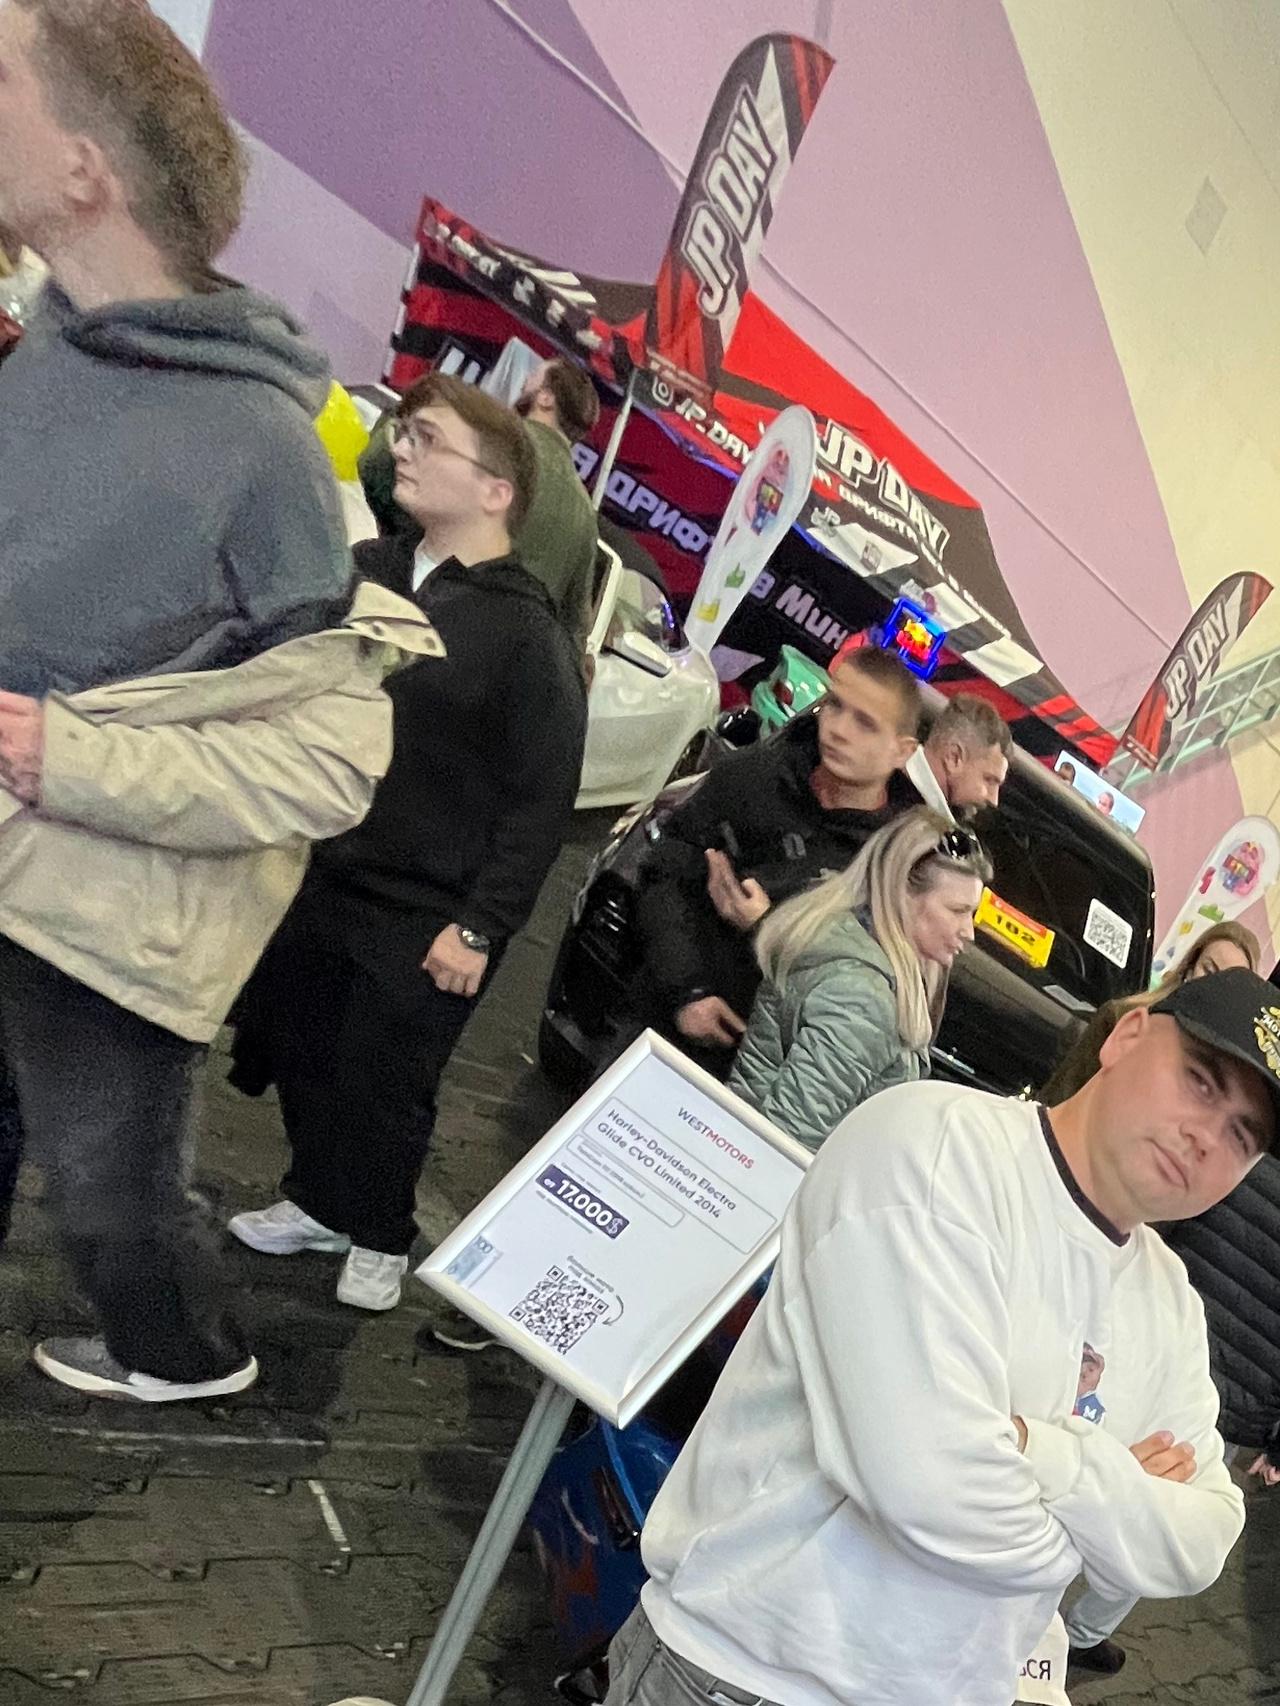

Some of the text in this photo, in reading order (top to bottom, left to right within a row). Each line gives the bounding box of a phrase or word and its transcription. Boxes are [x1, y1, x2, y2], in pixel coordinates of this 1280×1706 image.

[682, 88, 777, 317] JP DAY
[814, 422, 877, 487] JP
[880, 460, 948, 561] DAY
[1163, 597, 1229, 718] JP DAY
[597, 1121, 627, 1149] Glide
[628, 1145, 655, 1168] CVO
[653, 1164, 696, 1199] Limited
[693, 1194, 722, 1219] 2014
[607, 1109, 698, 1182] Harley-Davidson
[697, 1177, 737, 1211] Electra
[677, 1107, 755, 1170] WESTMOTORS
